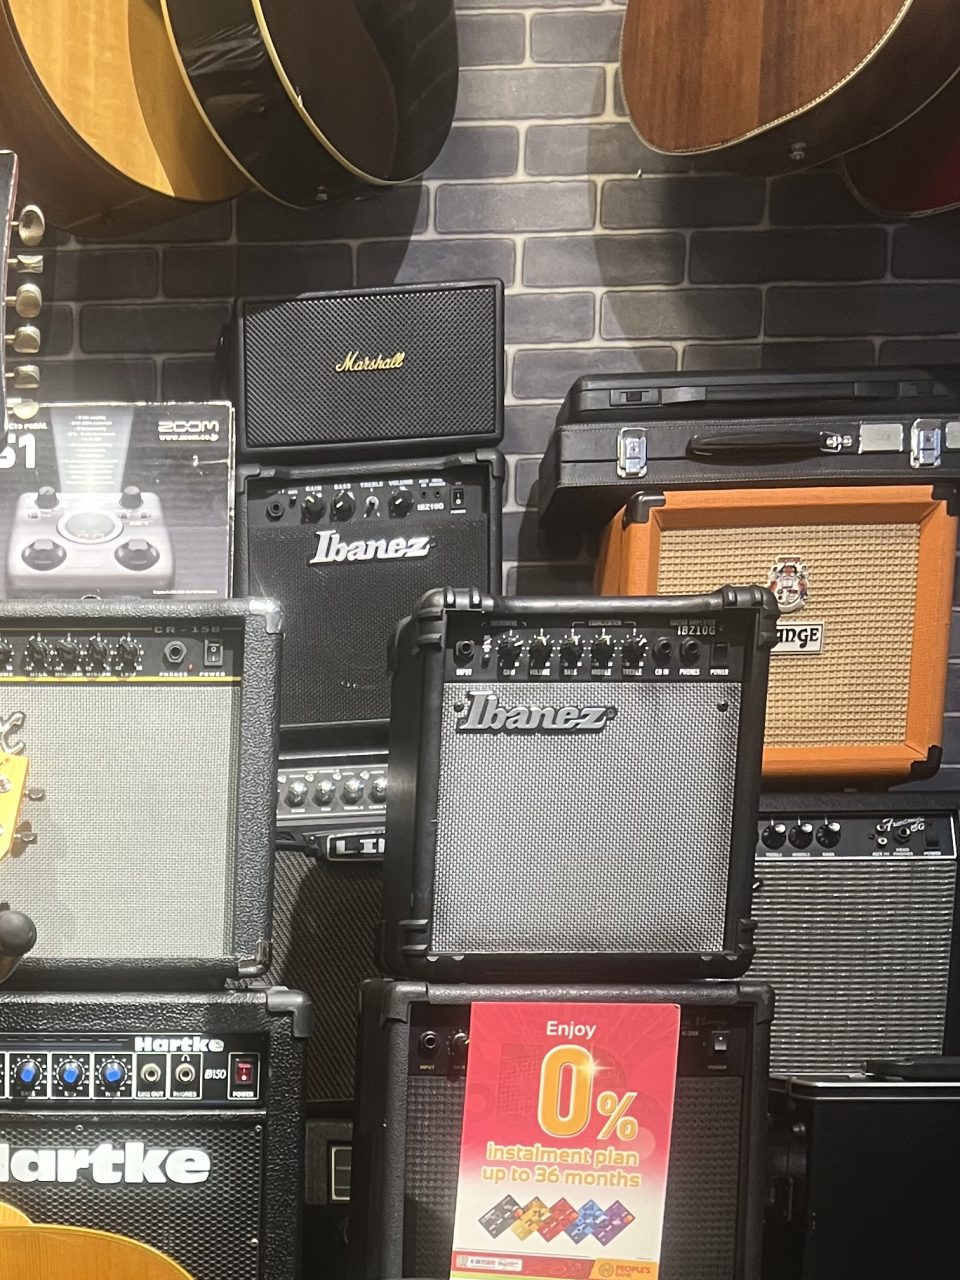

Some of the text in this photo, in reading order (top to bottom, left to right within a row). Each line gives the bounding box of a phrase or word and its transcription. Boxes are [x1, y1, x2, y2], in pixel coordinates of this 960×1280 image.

[335, 351, 406, 373] Marshall
[158, 420, 220, 433] ZOOM
[309, 529, 431, 564] Ibanez
[677, 625, 716, 636] IBZ10G
[459, 690, 609, 731] Ibanez
[545, 1020, 597, 1040] Enjoy
[134, 1036, 225, 1052] Hartke
[537, 1044, 639, 1141] 0%
[593, 1146, 640, 1168] plan
[482, 1166, 641, 1188] up to 36 months
